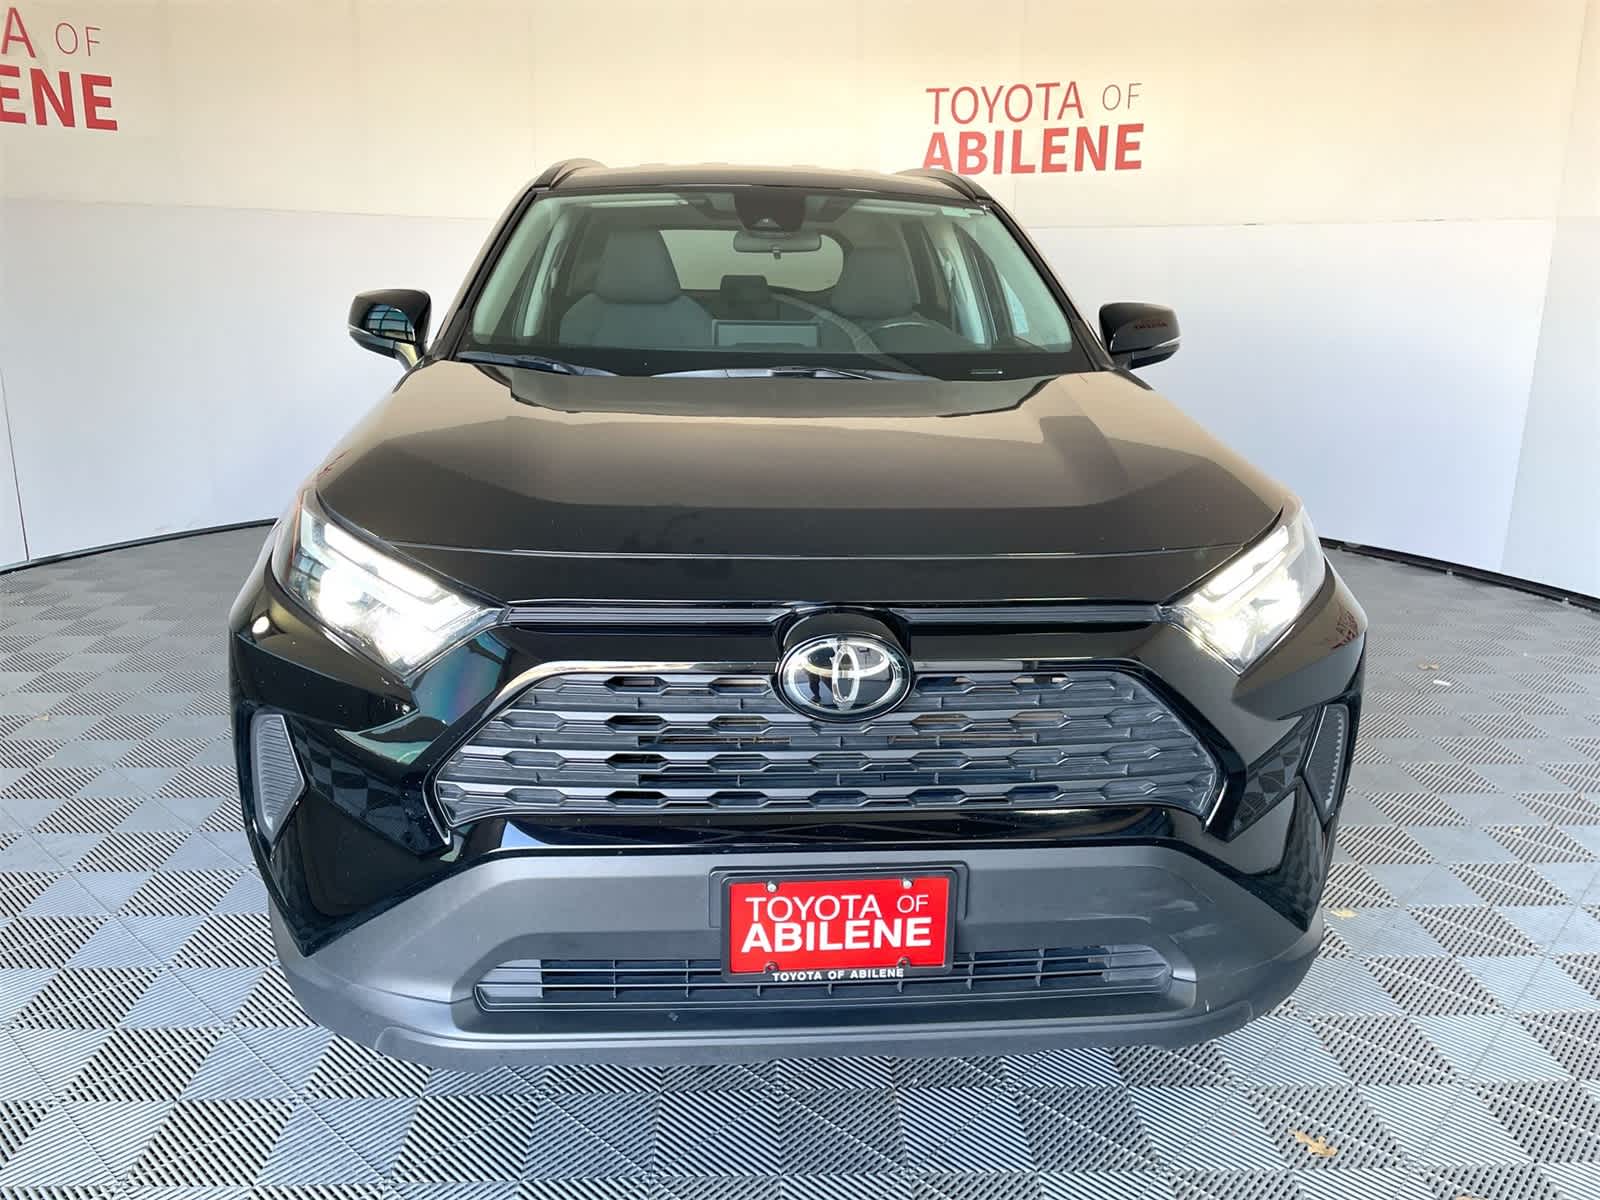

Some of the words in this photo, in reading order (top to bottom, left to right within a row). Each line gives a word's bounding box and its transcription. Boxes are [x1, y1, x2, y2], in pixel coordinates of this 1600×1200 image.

[55, 22, 101, 57] OF
[925, 81, 1084, 125] TOYOTA
[1102, 83, 1142, 111] OF
[922, 123, 1144, 175] ABILENE
[745, 894, 882, 922] TOYOTA
[896, 894, 929, 913] OF
[741, 917, 932, 953] ABILENE
[772, 972, 822, 982] TOYOTA
[828, 971, 845, 980] OF
[850, 968, 904, 979] ABILENE
